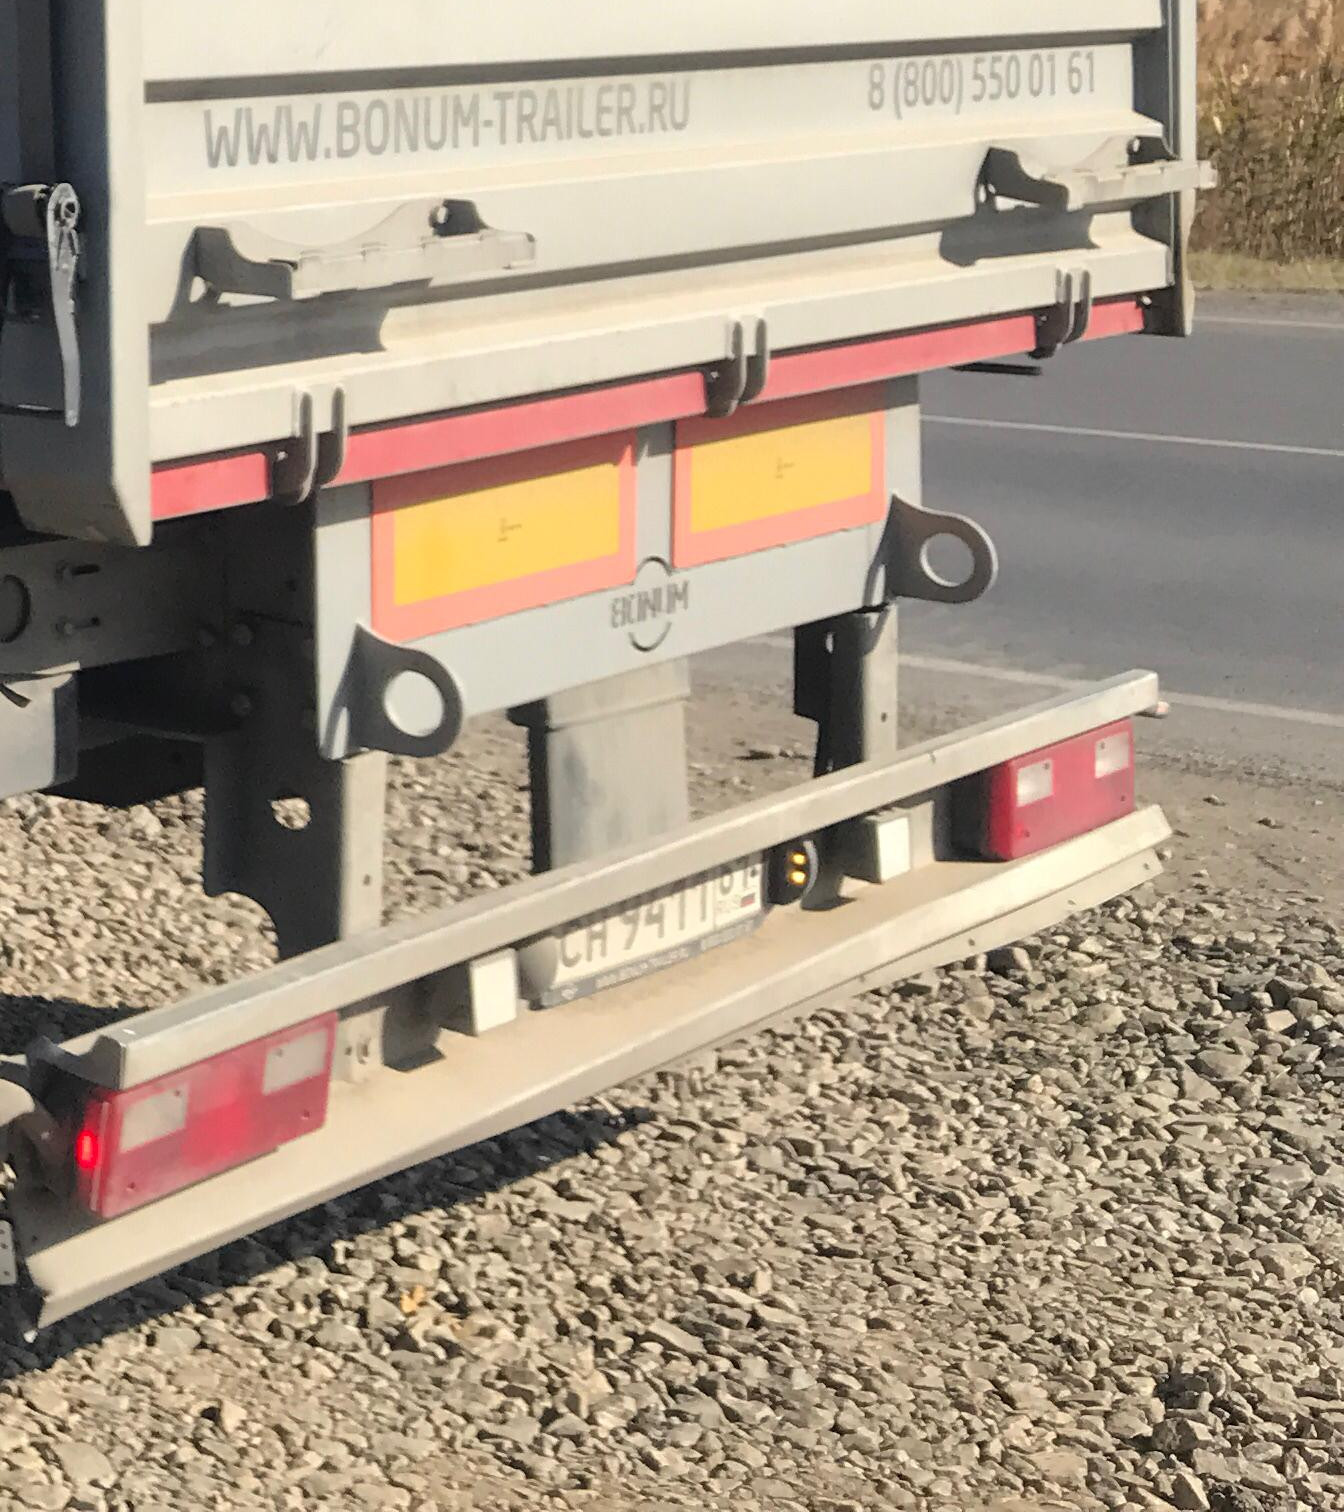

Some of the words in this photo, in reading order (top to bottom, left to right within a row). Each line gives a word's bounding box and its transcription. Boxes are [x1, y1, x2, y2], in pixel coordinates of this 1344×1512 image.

[868, 62, 886, 112] 8
[894, 58, 964, 121] (800)
[972, 54, 1022, 104] 550
[1028, 51, 1057, 98] 01
[1067, 49, 1095, 95] 61
[203, 79, 693, 169] WWW.BONUM-TRAILER.RU
[611, 580, 689, 629] BONUM
